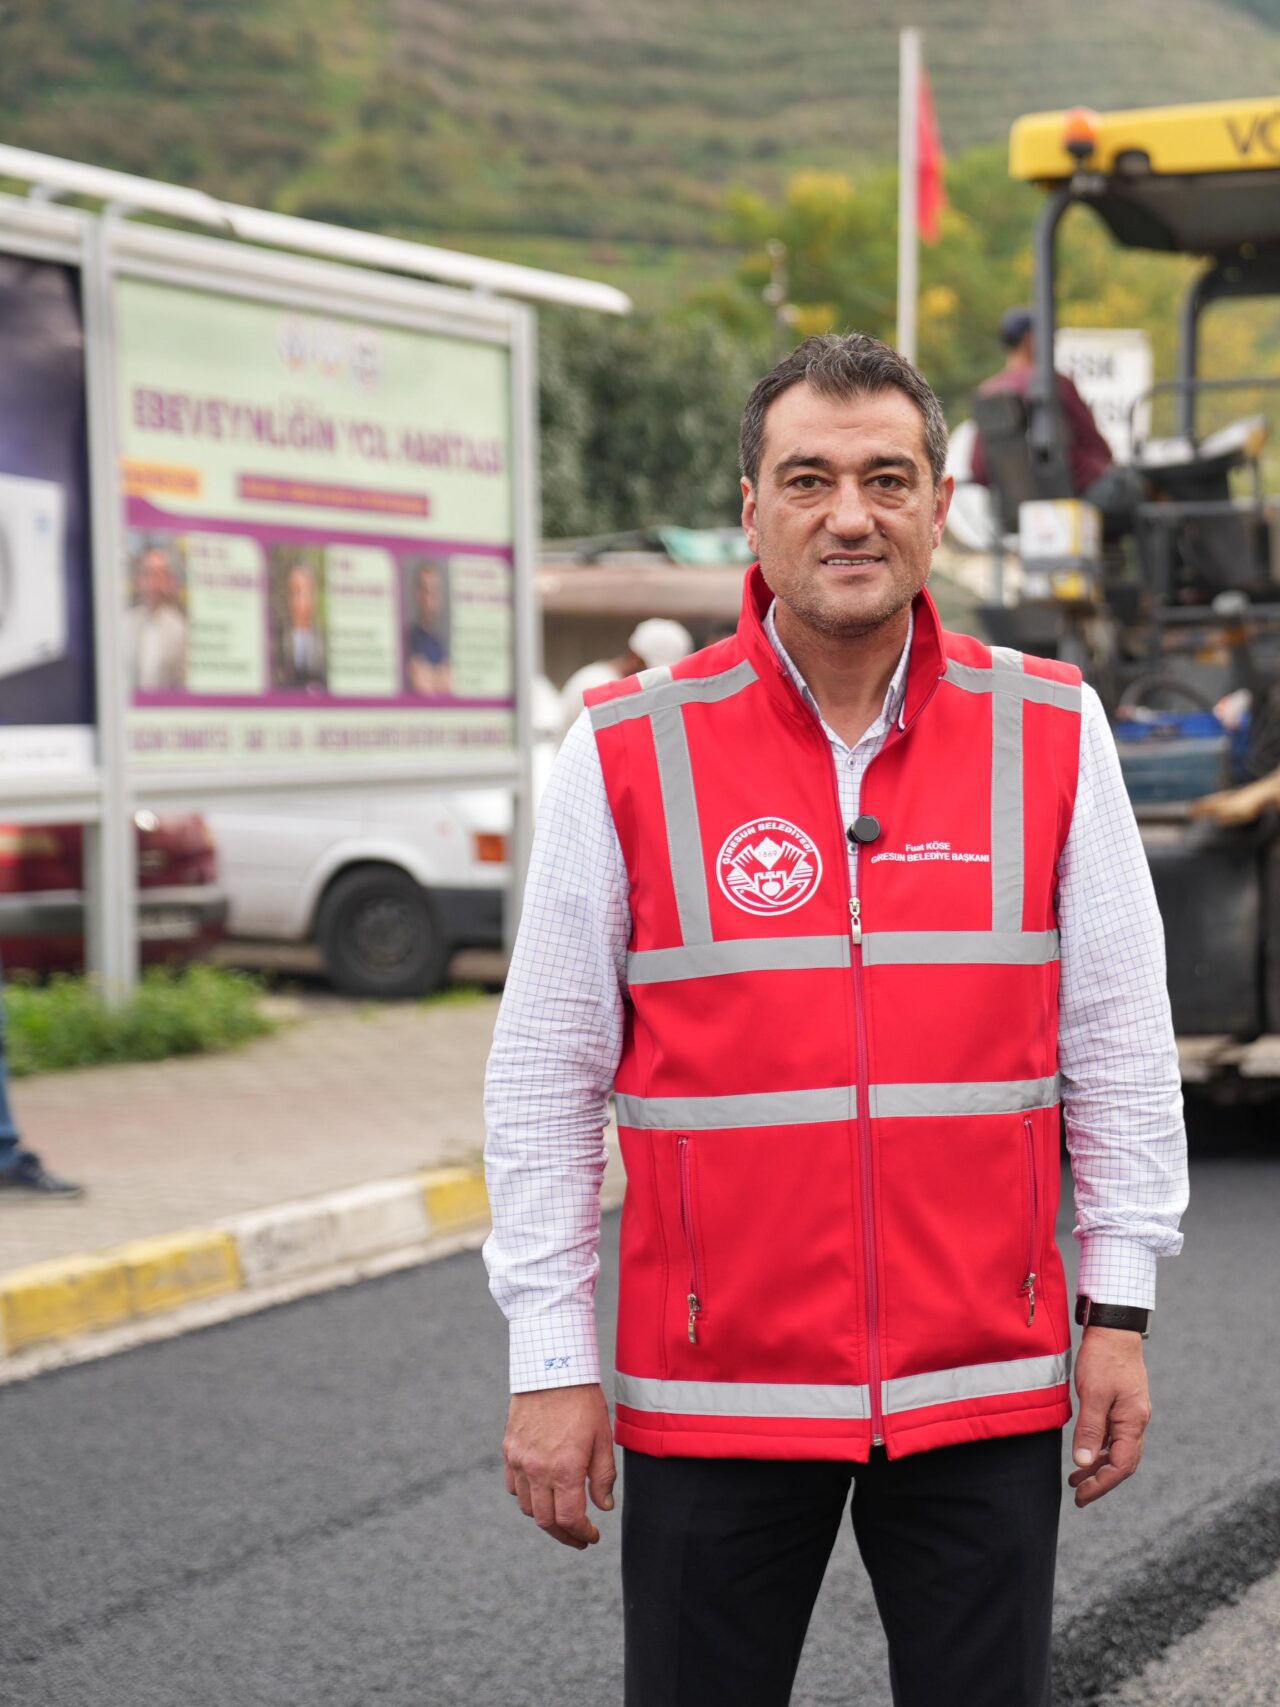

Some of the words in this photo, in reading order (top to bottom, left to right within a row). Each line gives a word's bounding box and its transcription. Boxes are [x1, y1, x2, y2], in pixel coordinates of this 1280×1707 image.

[757, 821, 814, 852] BELEDİYESİ
[905, 843, 925, 852] Fuat
[926, 840, 951, 851] KÖSE
[906, 850, 951, 862] BELEDİYE
[951, 853, 991, 863] BAŞKANI
